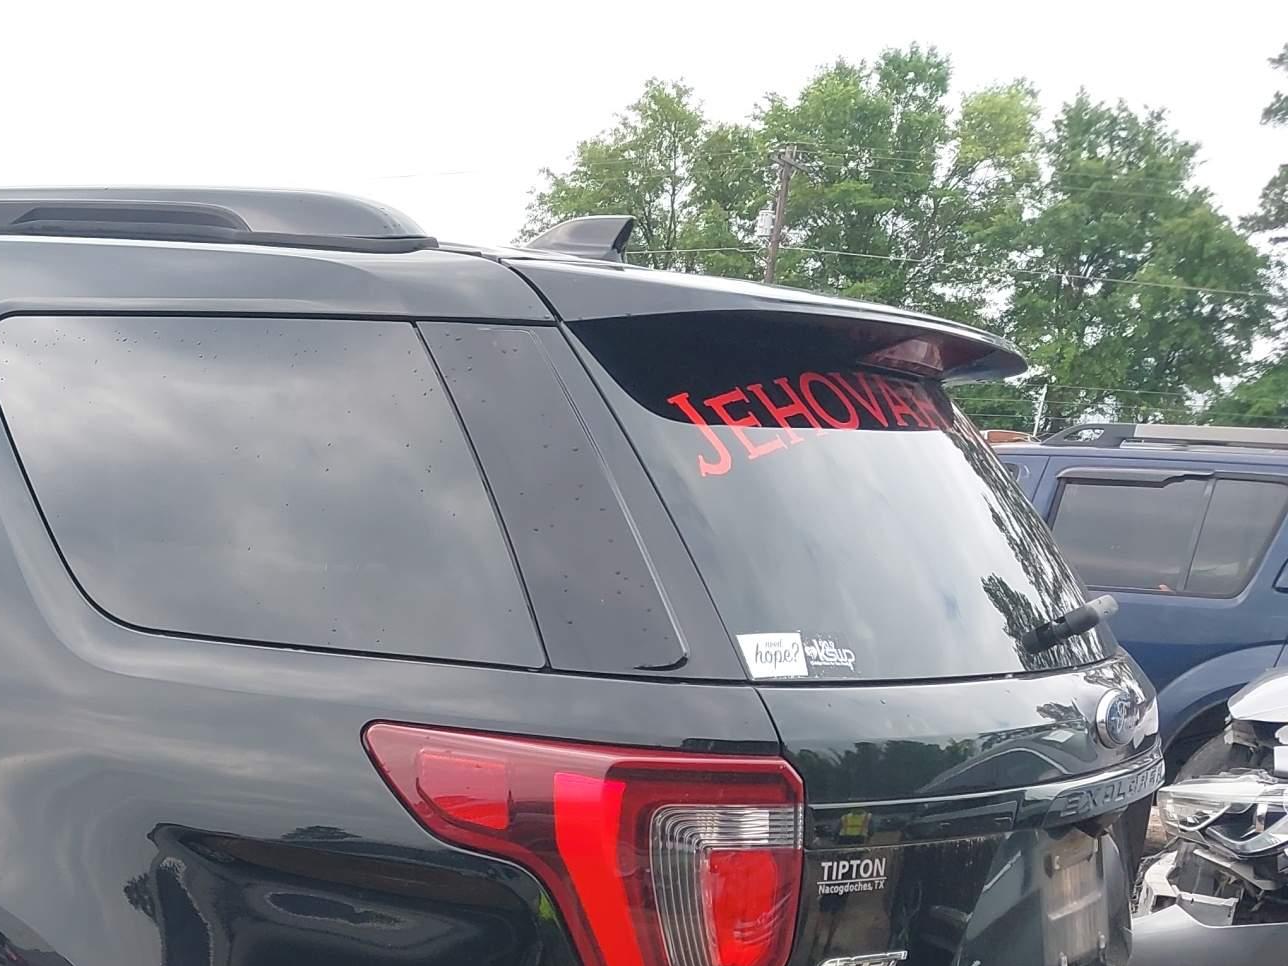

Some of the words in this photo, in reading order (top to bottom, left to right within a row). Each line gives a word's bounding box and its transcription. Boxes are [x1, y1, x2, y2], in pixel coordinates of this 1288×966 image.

[667, 371, 952, 477] JEHOVAH
[755, 642, 800, 670] hope?
[821, 857, 886, 881] TIPTON
[874, 880, 885, 889] TX
